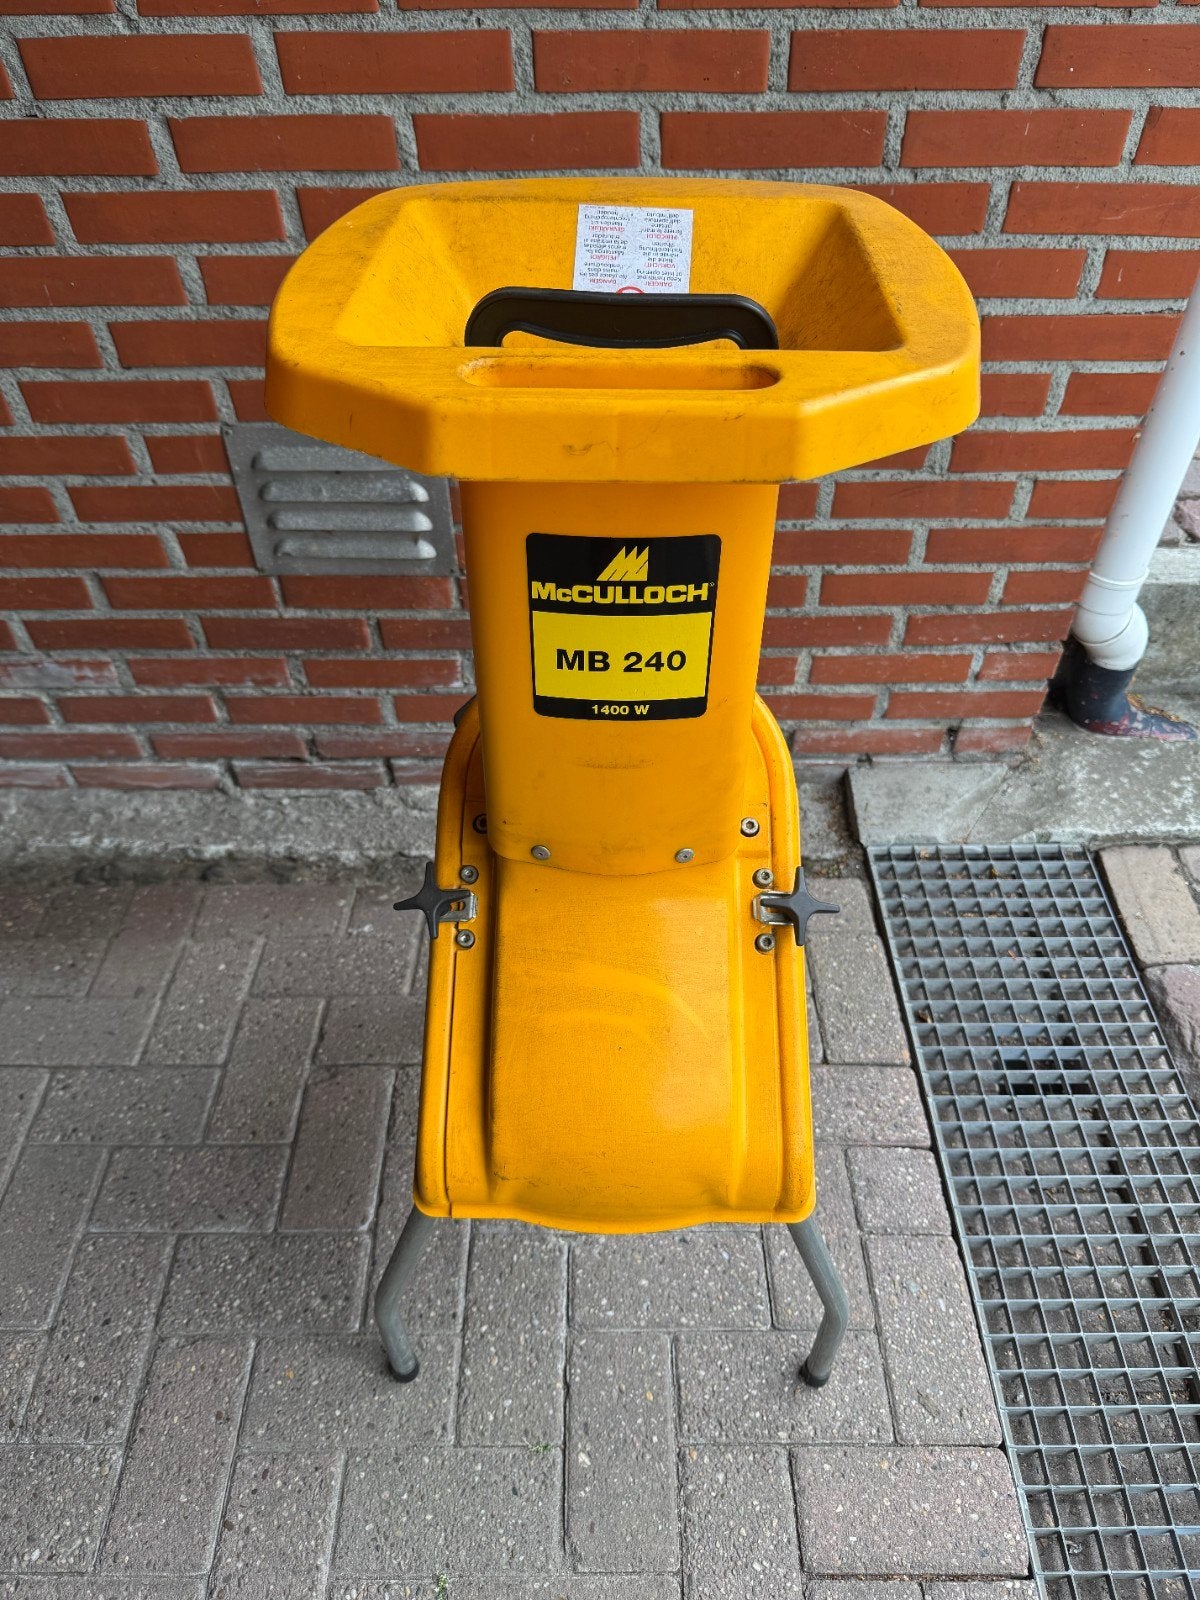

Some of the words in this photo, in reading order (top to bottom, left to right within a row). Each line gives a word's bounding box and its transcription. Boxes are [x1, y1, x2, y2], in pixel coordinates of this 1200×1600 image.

[532, 581, 708, 604] McCULLOCH
[556, 648, 610, 672] MB
[623, 650, 686, 673] 240
[592, 704, 629, 715] 1400
[635, 704, 649, 715] W
